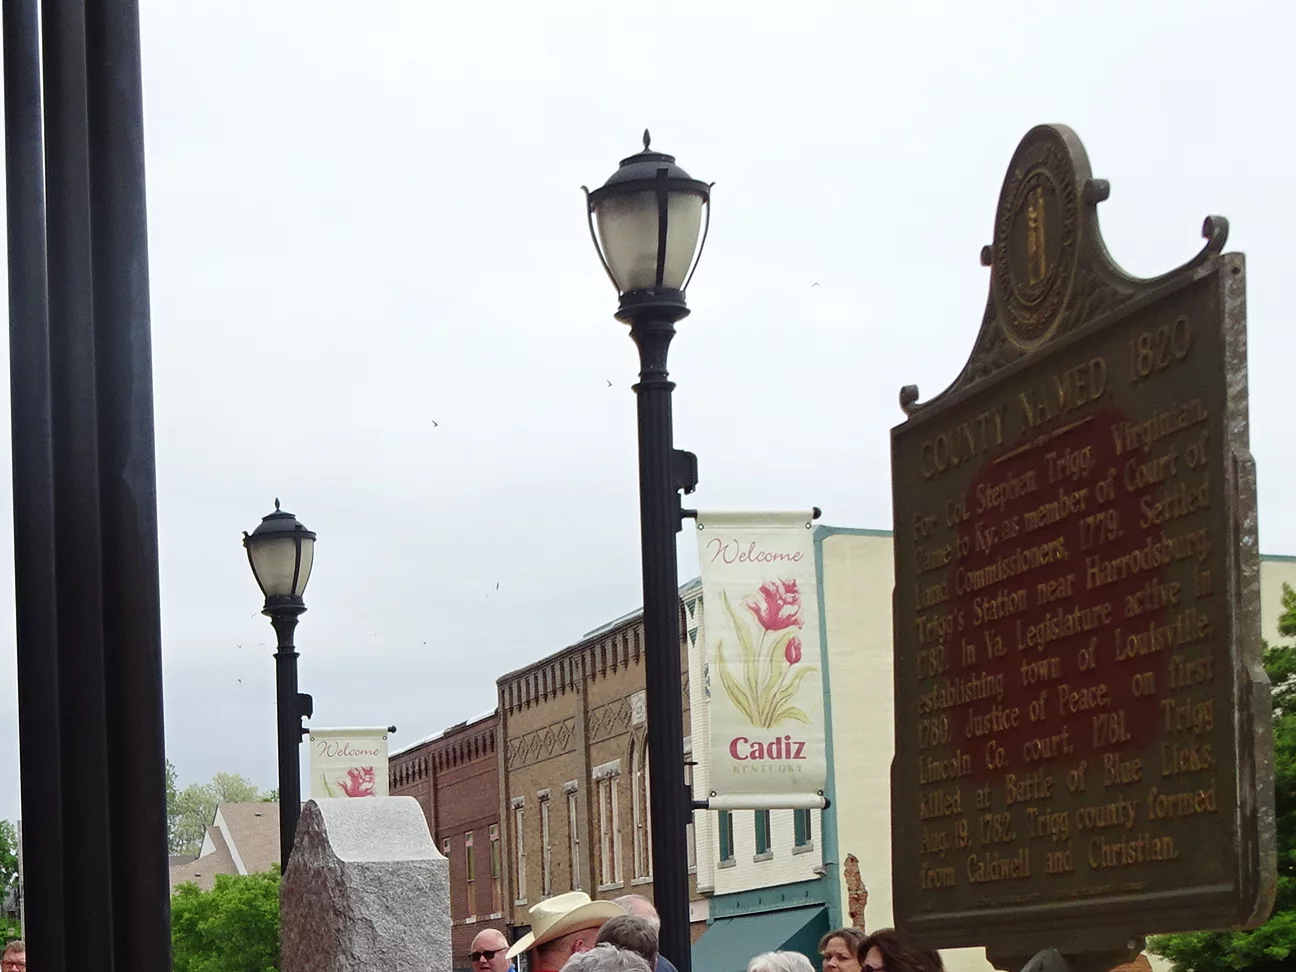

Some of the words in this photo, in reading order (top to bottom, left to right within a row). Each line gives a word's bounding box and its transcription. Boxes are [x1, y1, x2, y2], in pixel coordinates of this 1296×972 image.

[918, 405, 1007, 479] COUNTY
[1129, 315, 1195, 382] 1820
[912, 513, 937, 541] For
[976, 469, 1038, 514] Stephen
[913, 543, 952, 575] Came
[956, 533, 970, 557] to
[1024, 486, 1089, 534] member
[1095, 467, 1117, 503] of
[1125, 445, 1180, 493] Court
[1185, 430, 1211, 468] of
[706, 538, 804, 565] Welcome
[914, 579, 950, 610] Land
[955, 535, 1070, 596] Commissioners,
[1078, 508, 1124, 551] 1779.
[1139, 478, 1212, 532] Settled
[915, 607, 965, 646] Trigg's
[972, 585, 1028, 627] Station
[1036, 571, 1077, 607] near
[961, 639, 977, 667] In
[984, 629, 1007, 660] Va.
[1016, 599, 1113, 652] Legislature
[1123, 577, 1181, 619] active
[1193, 565, 1213, 598] in
[915, 671, 1005, 717] establishing
[1020, 655, 1062, 688] town
[1077, 636, 1099, 671] of
[965, 704, 1021, 740] Justice
[1028, 693, 1047, 723] of
[1057, 681, 1112, 717] Peace,
[1130, 670, 1157, 699] on
[1166, 650, 1215, 691] first
[316, 741, 382, 758] Welcome
[728, 735, 807, 761] Cadiz
[732, 763, 803, 774] KENTUCKY
[917, 748, 973, 786] Lincoln
[985, 739, 1009, 771] Co.
[1022, 724, 1075, 763] court,
[1091, 710, 1132, 750] 1781.
[1159, 695, 1216, 735] Trigg
[919, 787, 962, 821] killed
[975, 782, 992, 810] at
[1004, 766, 1054, 806] Battle
[1066, 759, 1090, 793] of
[1102, 753, 1144, 788] Blue
[979, 811, 1017, 847] 1782.
[1025, 805, 1070, 842] Trigg
[1075, 794, 1140, 832] county
[1146, 777, 1220, 821] formed
[919, 863, 957, 891] from
[967, 848, 1032, 885] Caldwell
[1043, 841, 1076, 876] and
[1087, 833, 1181, 870] Christian.
